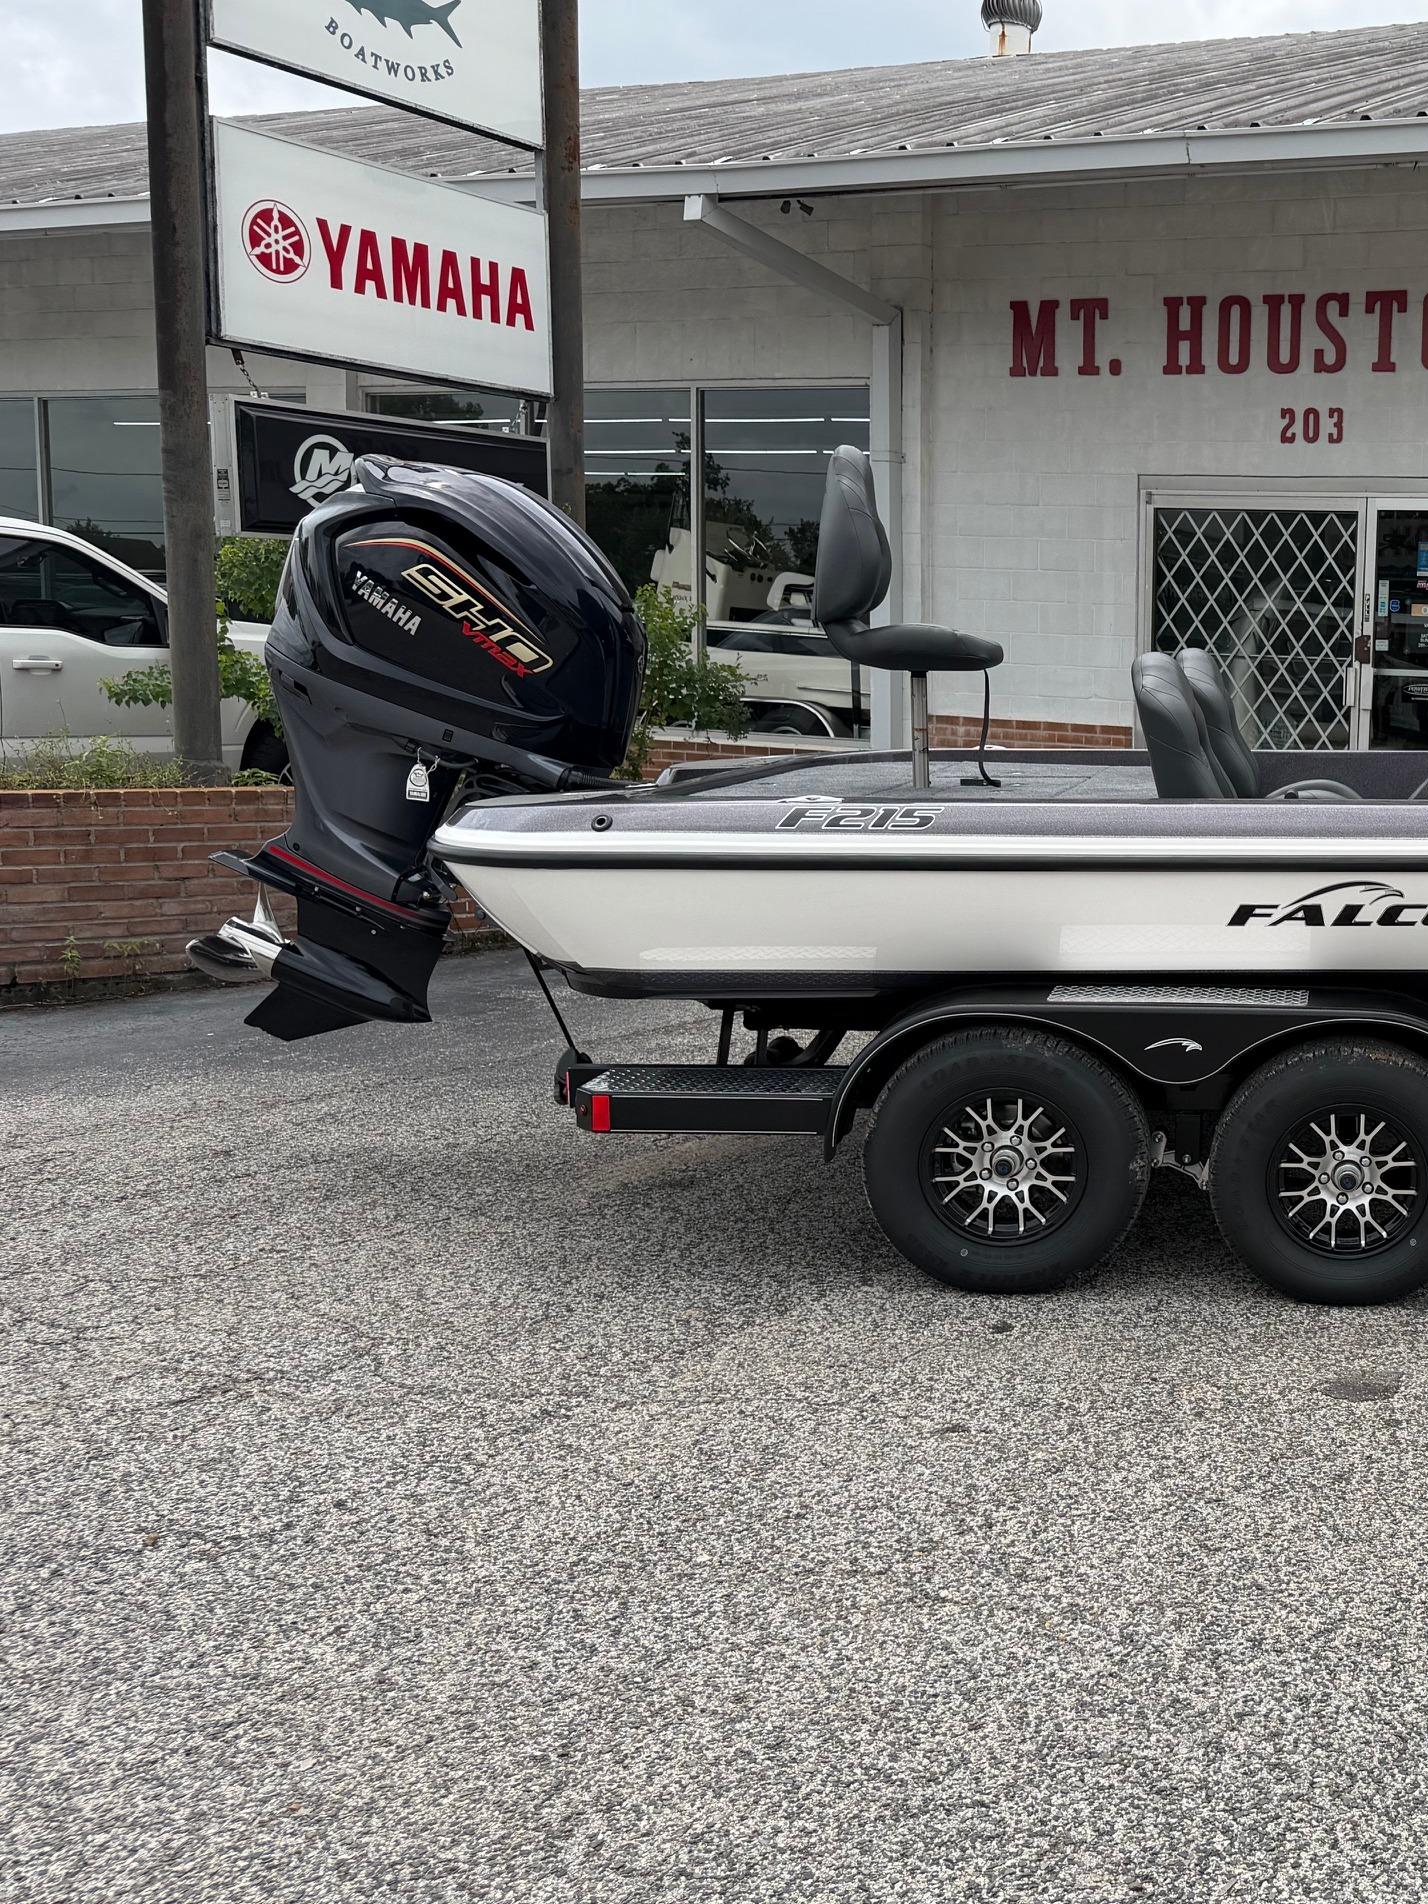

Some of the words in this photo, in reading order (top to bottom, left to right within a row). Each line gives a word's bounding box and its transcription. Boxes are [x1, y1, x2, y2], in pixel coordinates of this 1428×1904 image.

[325, 17, 454, 82] BOATWORKS
[316, 217, 536, 333] YAMAHA
[1009, 298, 1121, 377] MT.
[1280, 407, 1345, 444] 203
[352, 570, 422, 636] YAMAHA
[775, 806, 945, 831] F215
